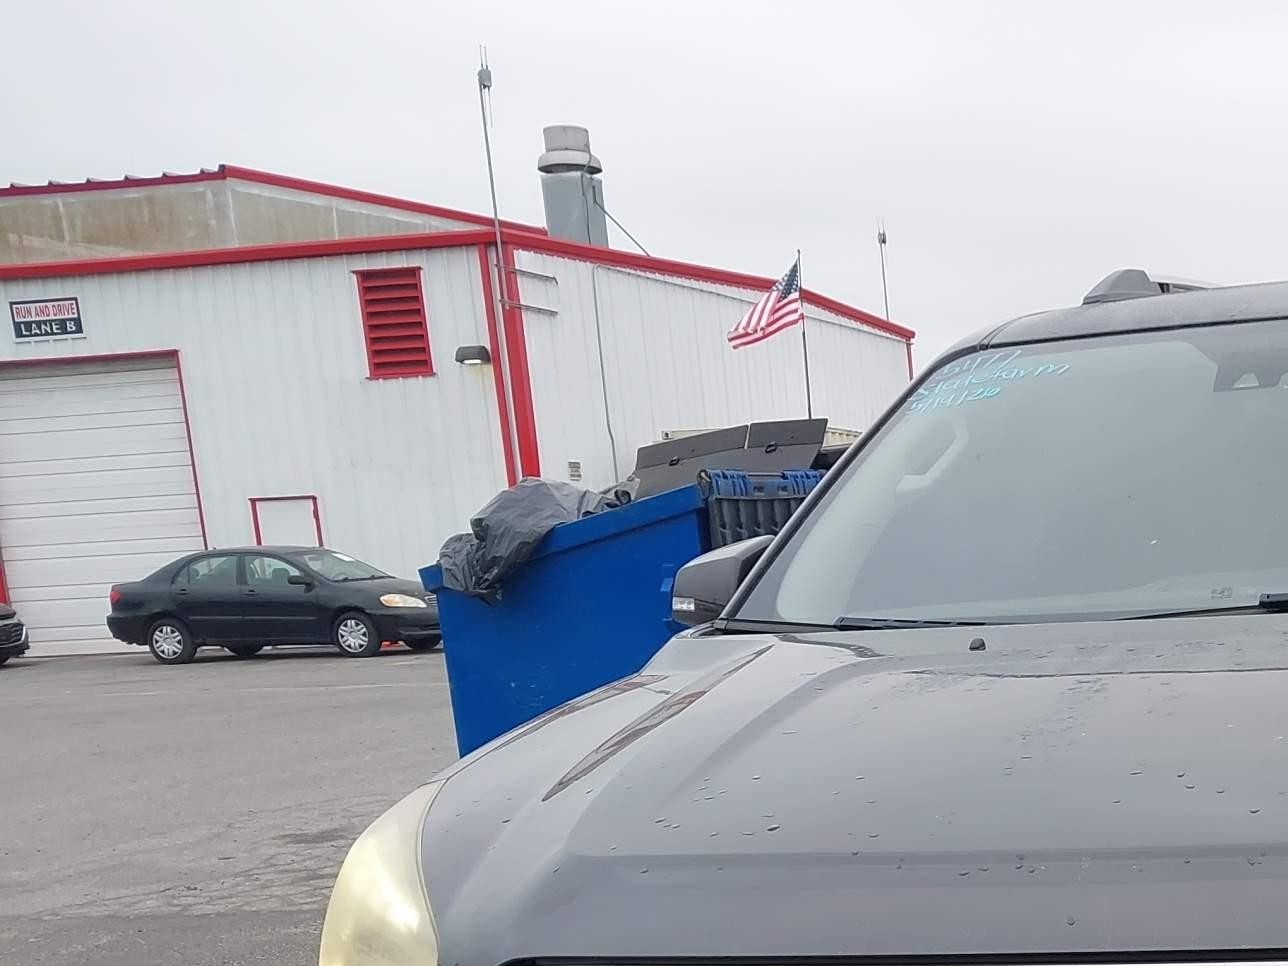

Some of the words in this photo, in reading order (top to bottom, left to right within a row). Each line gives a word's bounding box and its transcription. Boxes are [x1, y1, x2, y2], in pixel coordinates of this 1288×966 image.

[15, 306, 33, 319] RUN
[34, 305, 50, 318] AND
[52, 303, 76, 317] DRIVE
[20, 322, 62, 335] LANE
[66, 320, 76, 332] B
